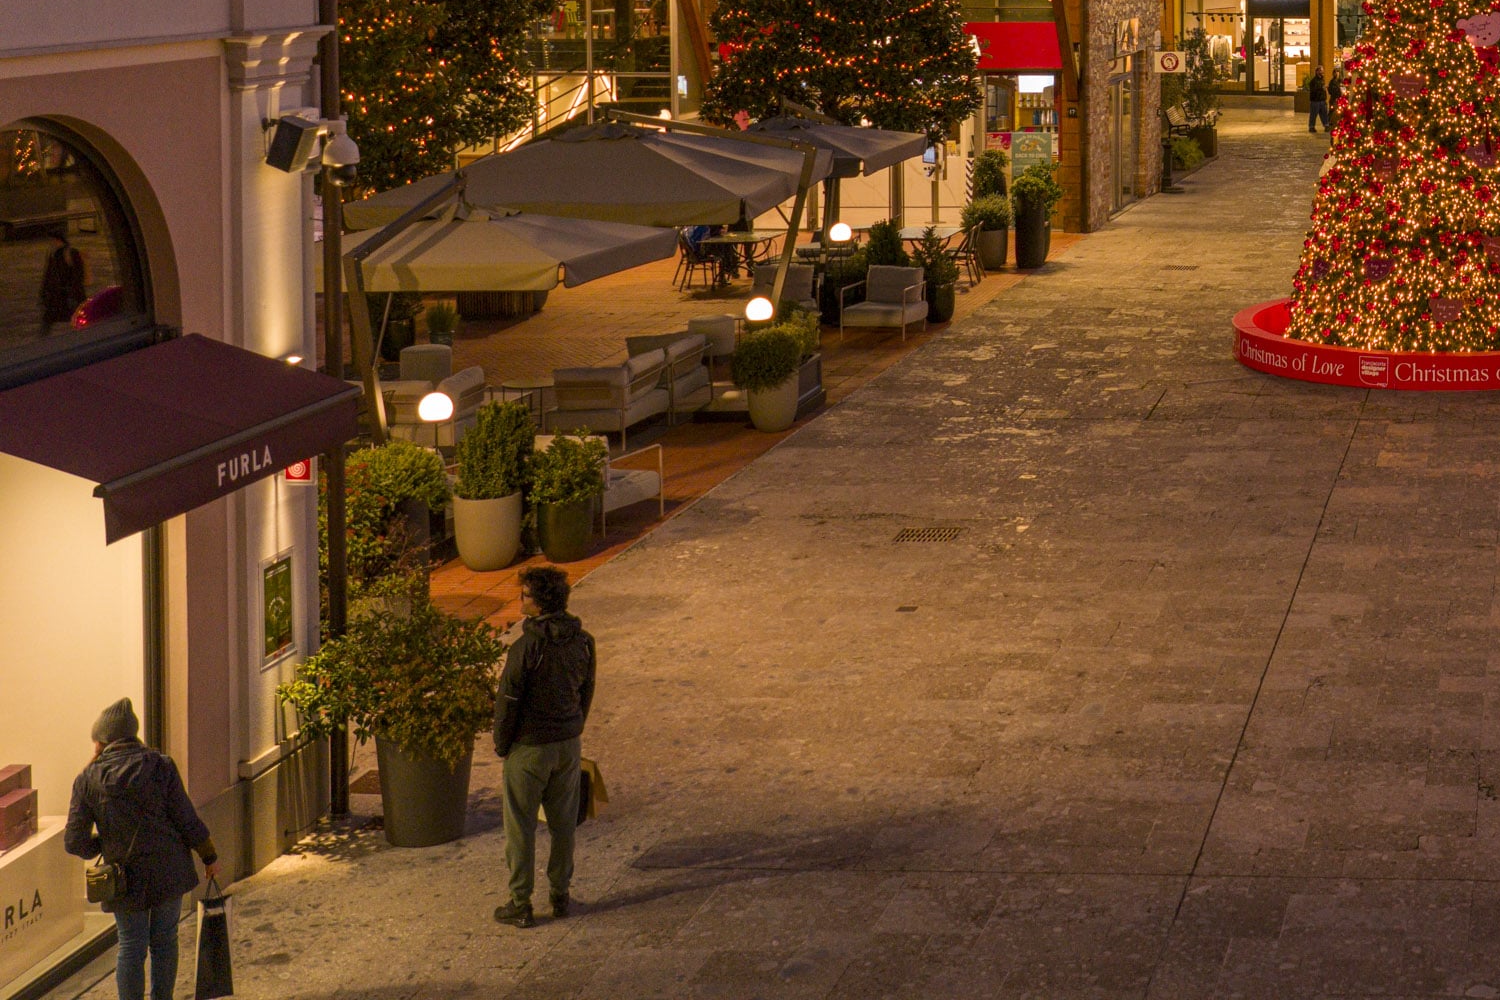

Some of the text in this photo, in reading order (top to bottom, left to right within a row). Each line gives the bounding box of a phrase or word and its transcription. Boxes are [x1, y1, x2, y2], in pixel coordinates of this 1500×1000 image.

[1240, 338, 1345, 377] Christmas of Love
[1394, 362, 1489, 382] Christmas
[217, 444, 273, 487] FURLA
